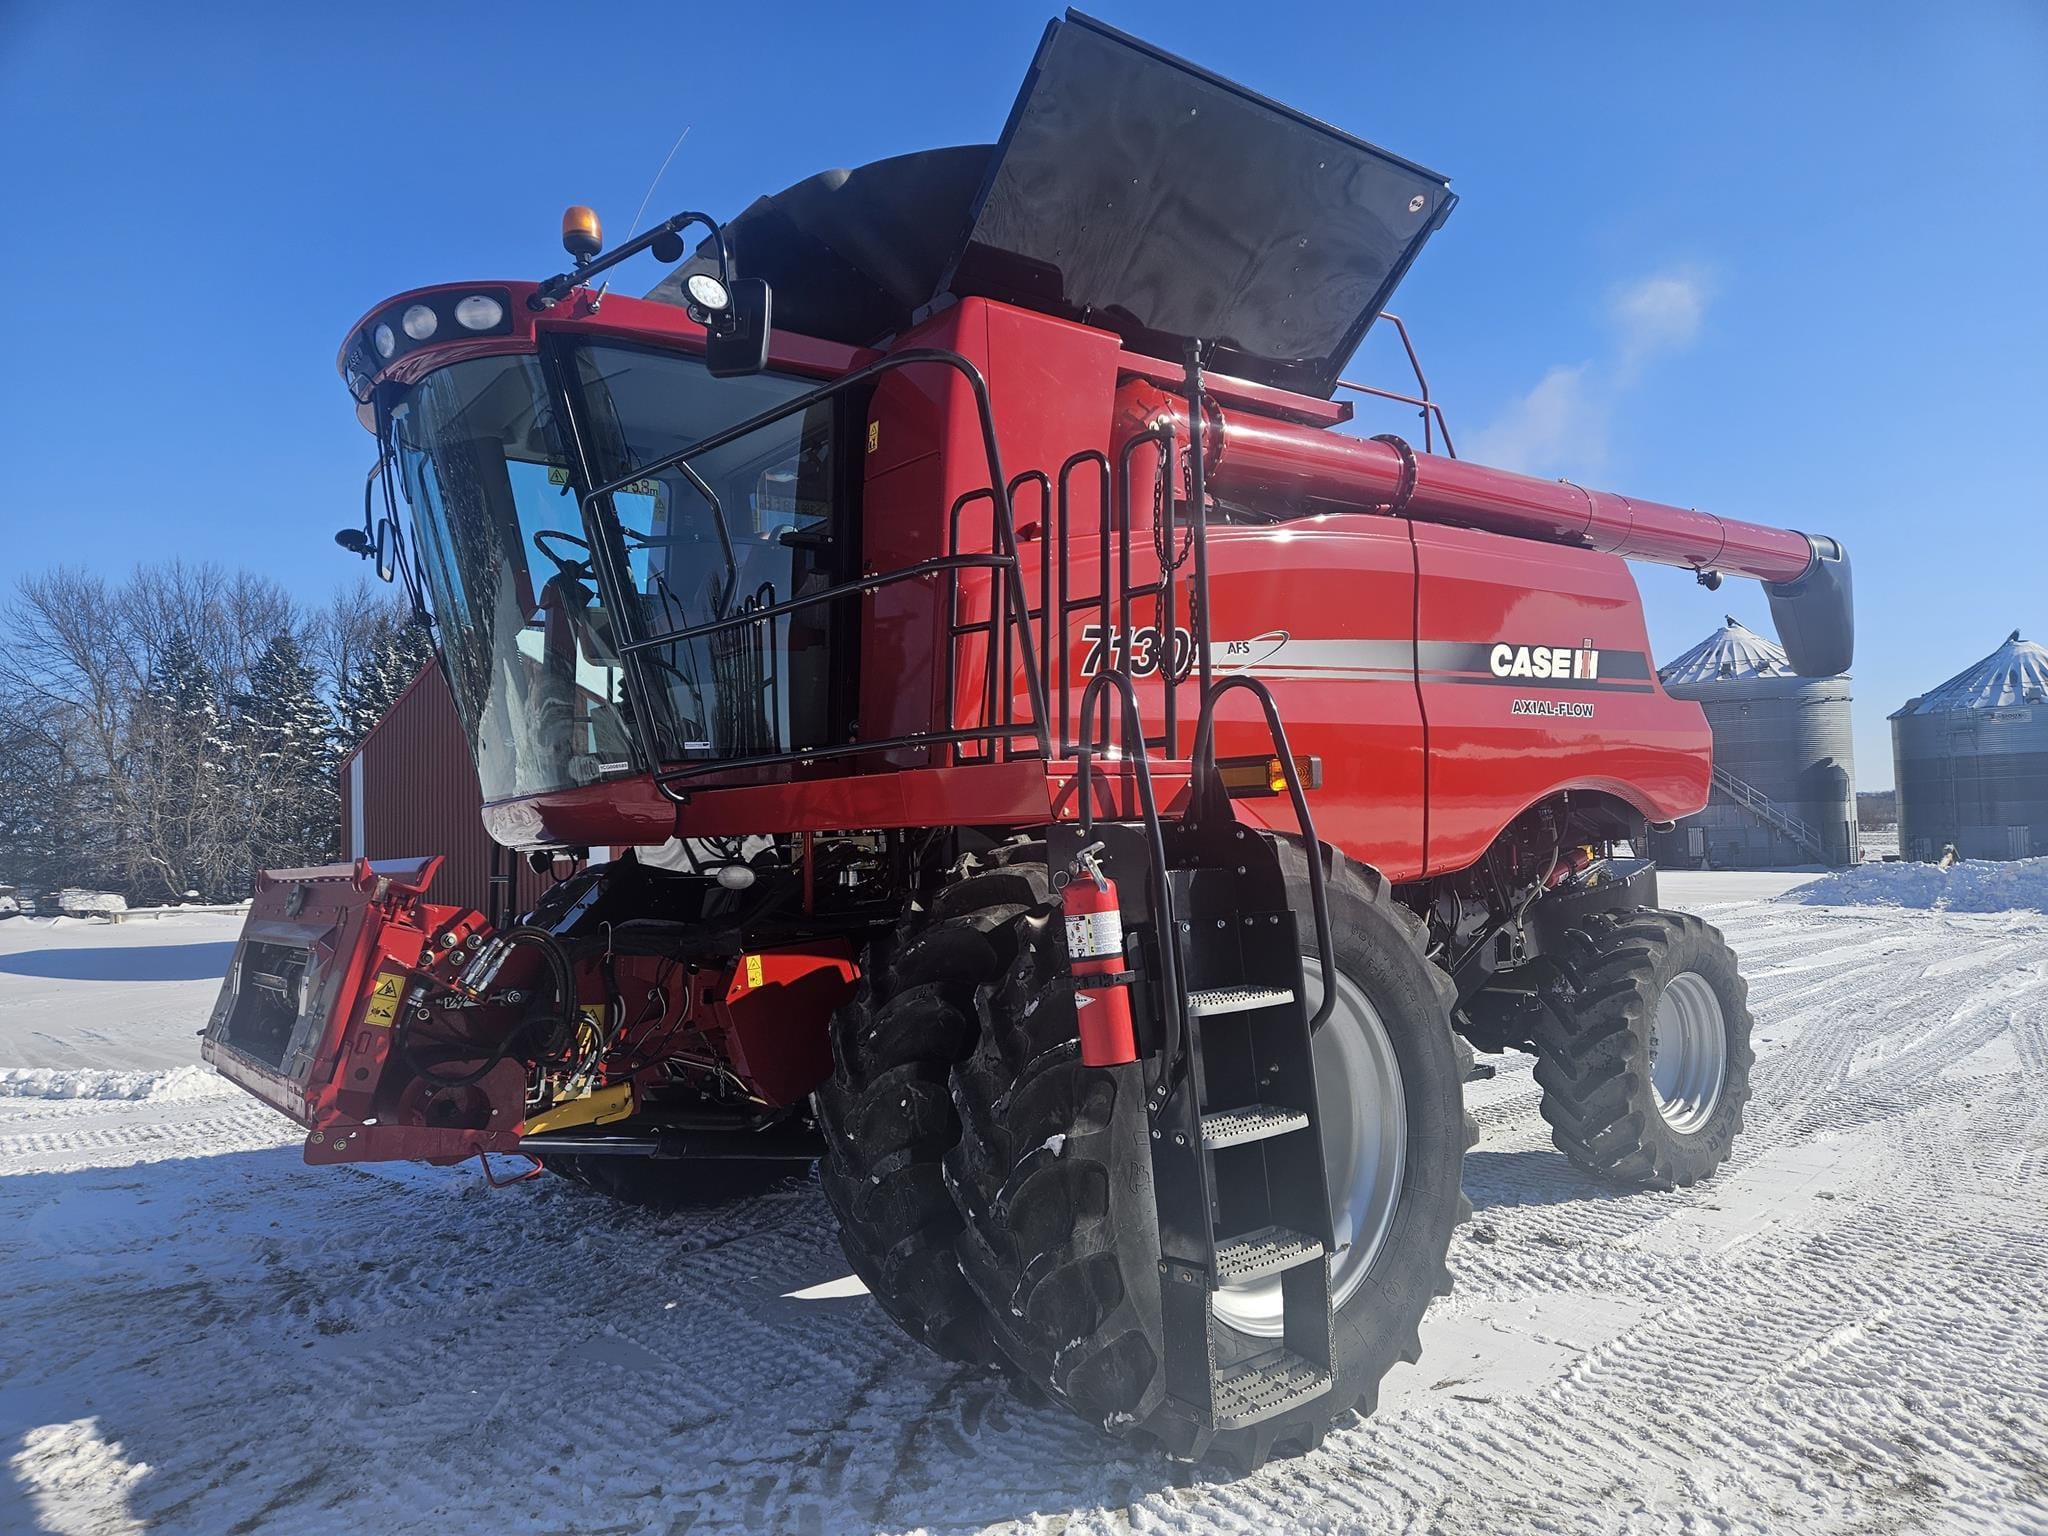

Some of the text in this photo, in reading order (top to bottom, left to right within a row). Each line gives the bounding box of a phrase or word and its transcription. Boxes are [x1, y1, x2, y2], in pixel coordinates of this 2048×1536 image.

[1227, 641, 1250, 655] AFS
[1490, 644, 1572, 679] CASE
[1511, 699, 1595, 718] AXIAL-FLOW
